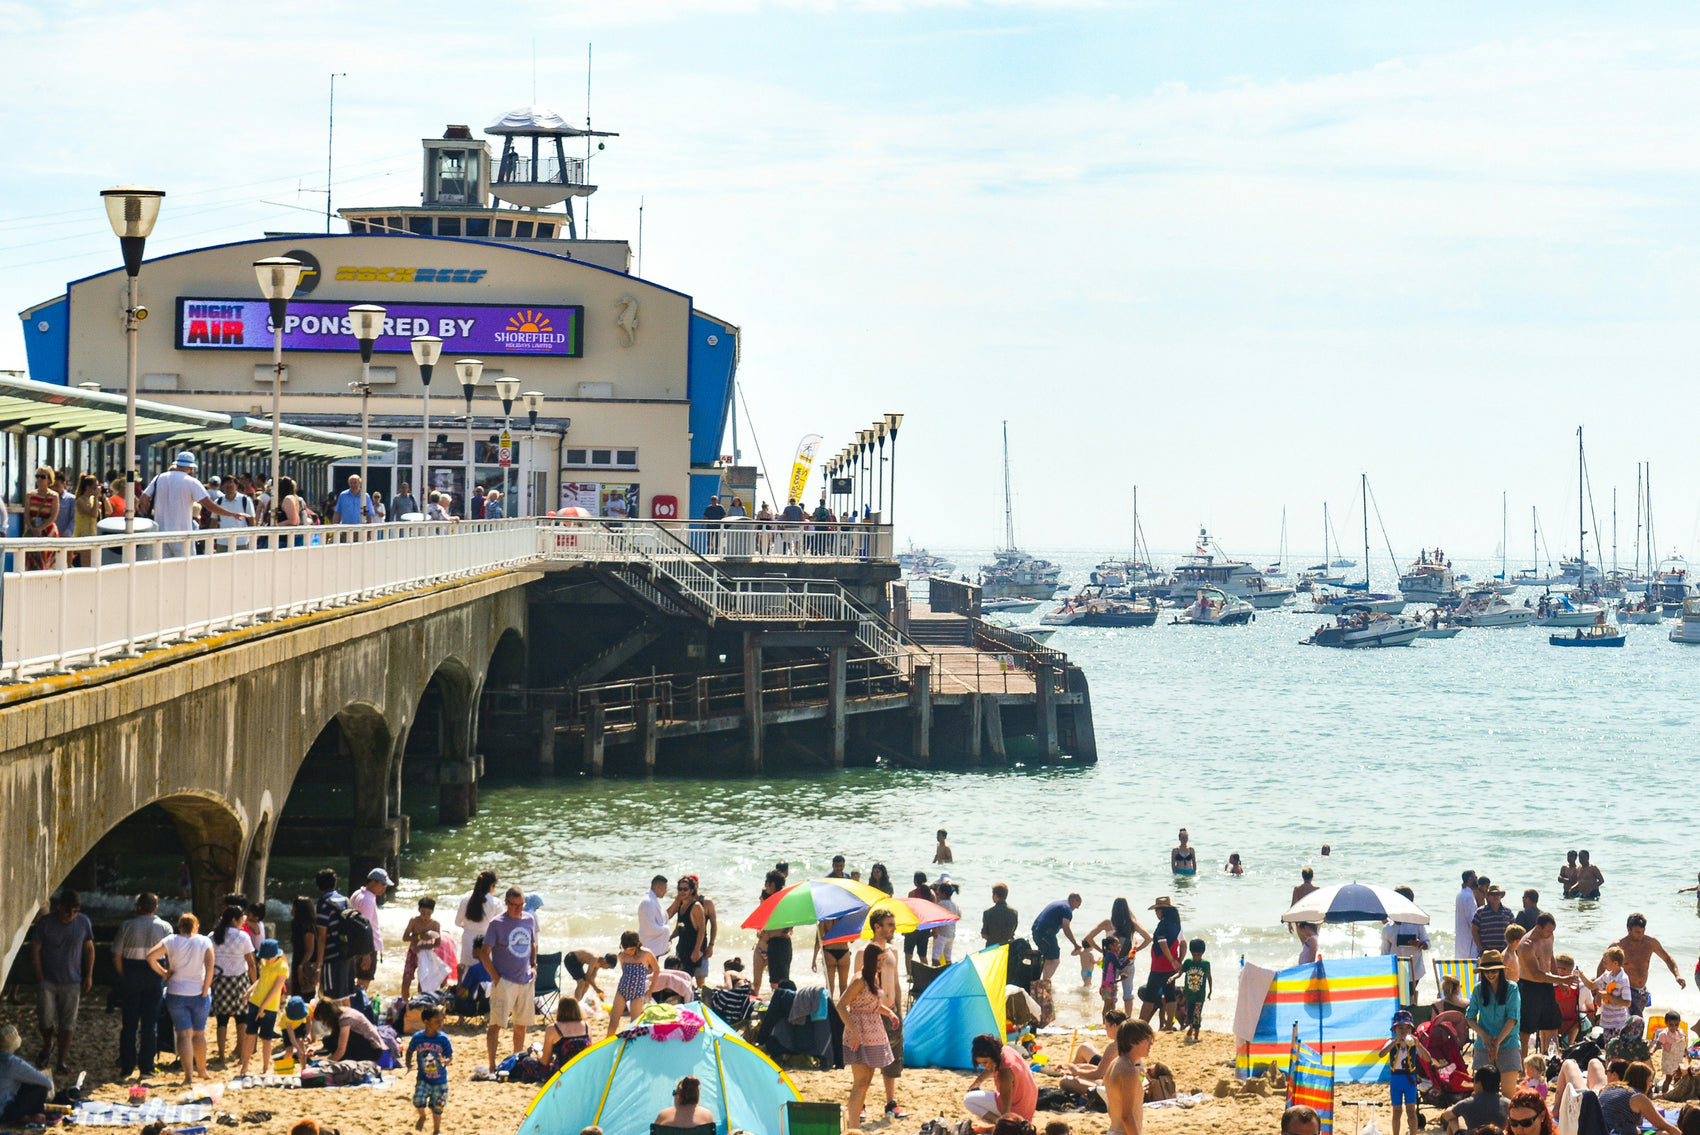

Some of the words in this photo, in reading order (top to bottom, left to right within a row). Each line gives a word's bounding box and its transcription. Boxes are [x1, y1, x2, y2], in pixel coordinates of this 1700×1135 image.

[188, 304, 244, 319] NIGHT
[187, 320, 244, 344] AIR
[438, 318, 476, 338] BY
[494, 331, 566, 344] SHOREFIELD
